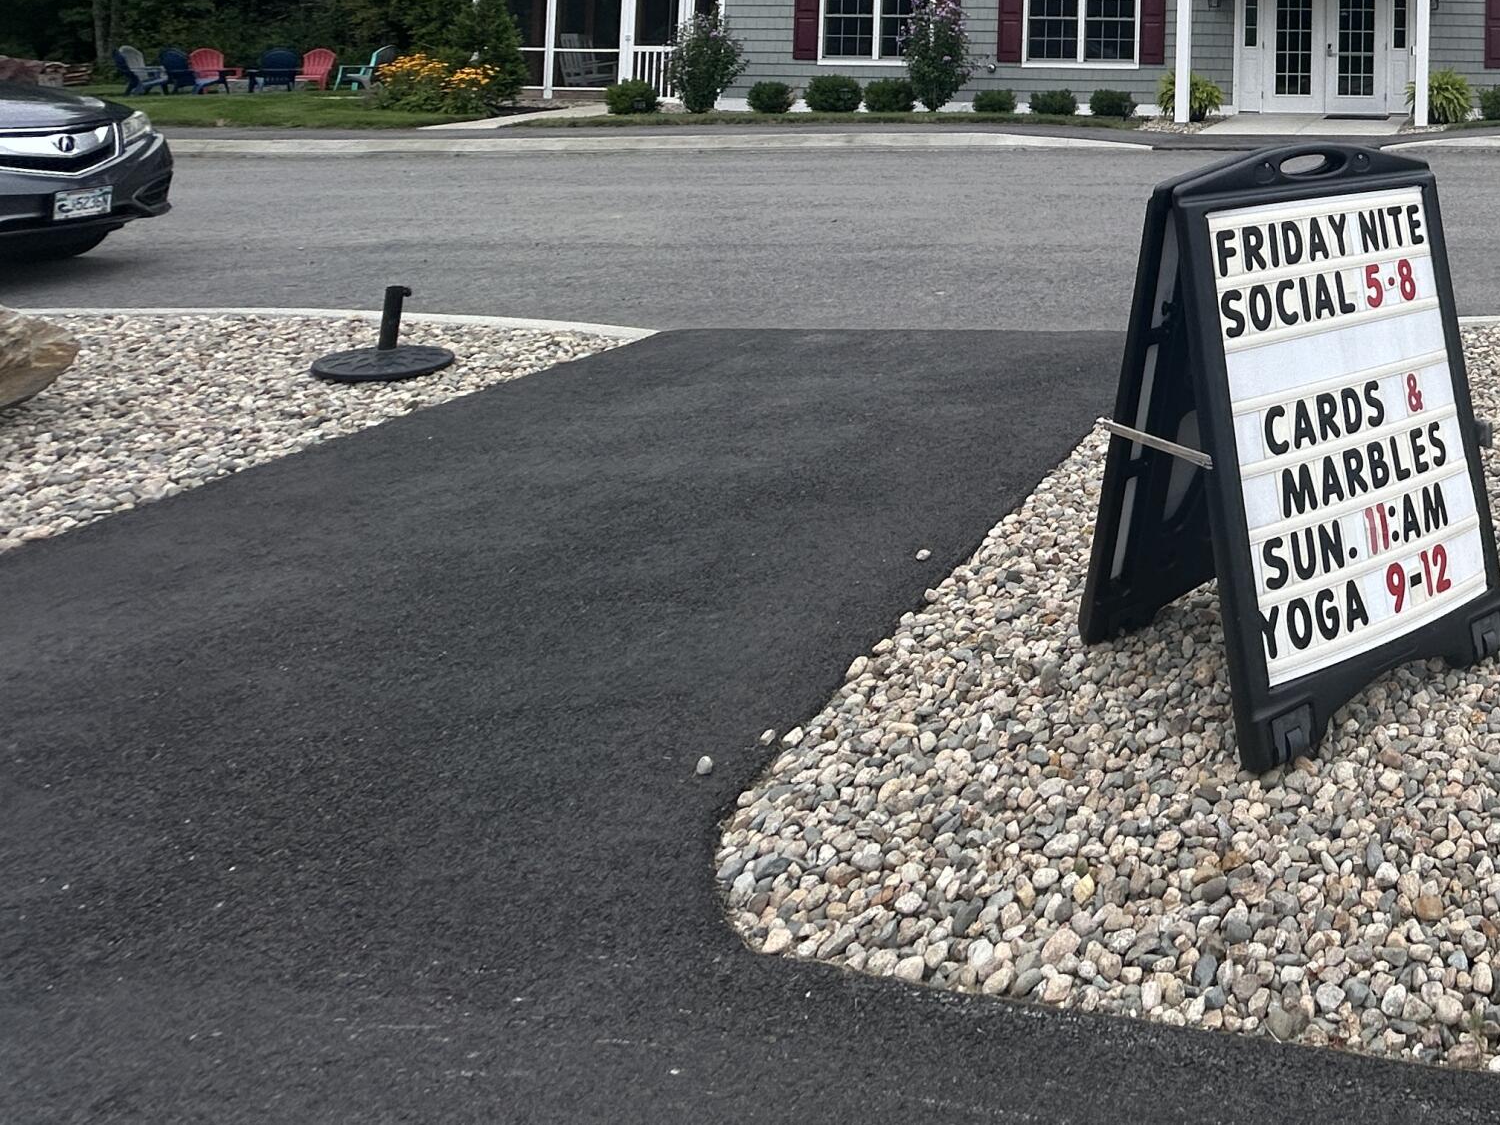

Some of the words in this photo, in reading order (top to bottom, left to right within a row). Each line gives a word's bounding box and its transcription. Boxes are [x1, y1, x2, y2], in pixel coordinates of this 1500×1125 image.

[1216, 213, 1346, 277] FRIDAY
[1358, 204, 1424, 254] NITE
[1220, 270, 1356, 338] SOCIAL
[1264, 380, 1385, 455] CARDS
[1406, 373, 1423, 412] &
[1282, 421, 1446, 518] MARBLES
[1262, 519, 1358, 590] SUN.
[1258, 579, 1369, 660] YOGA
[1386, 544, 1451, 613] 9-12
